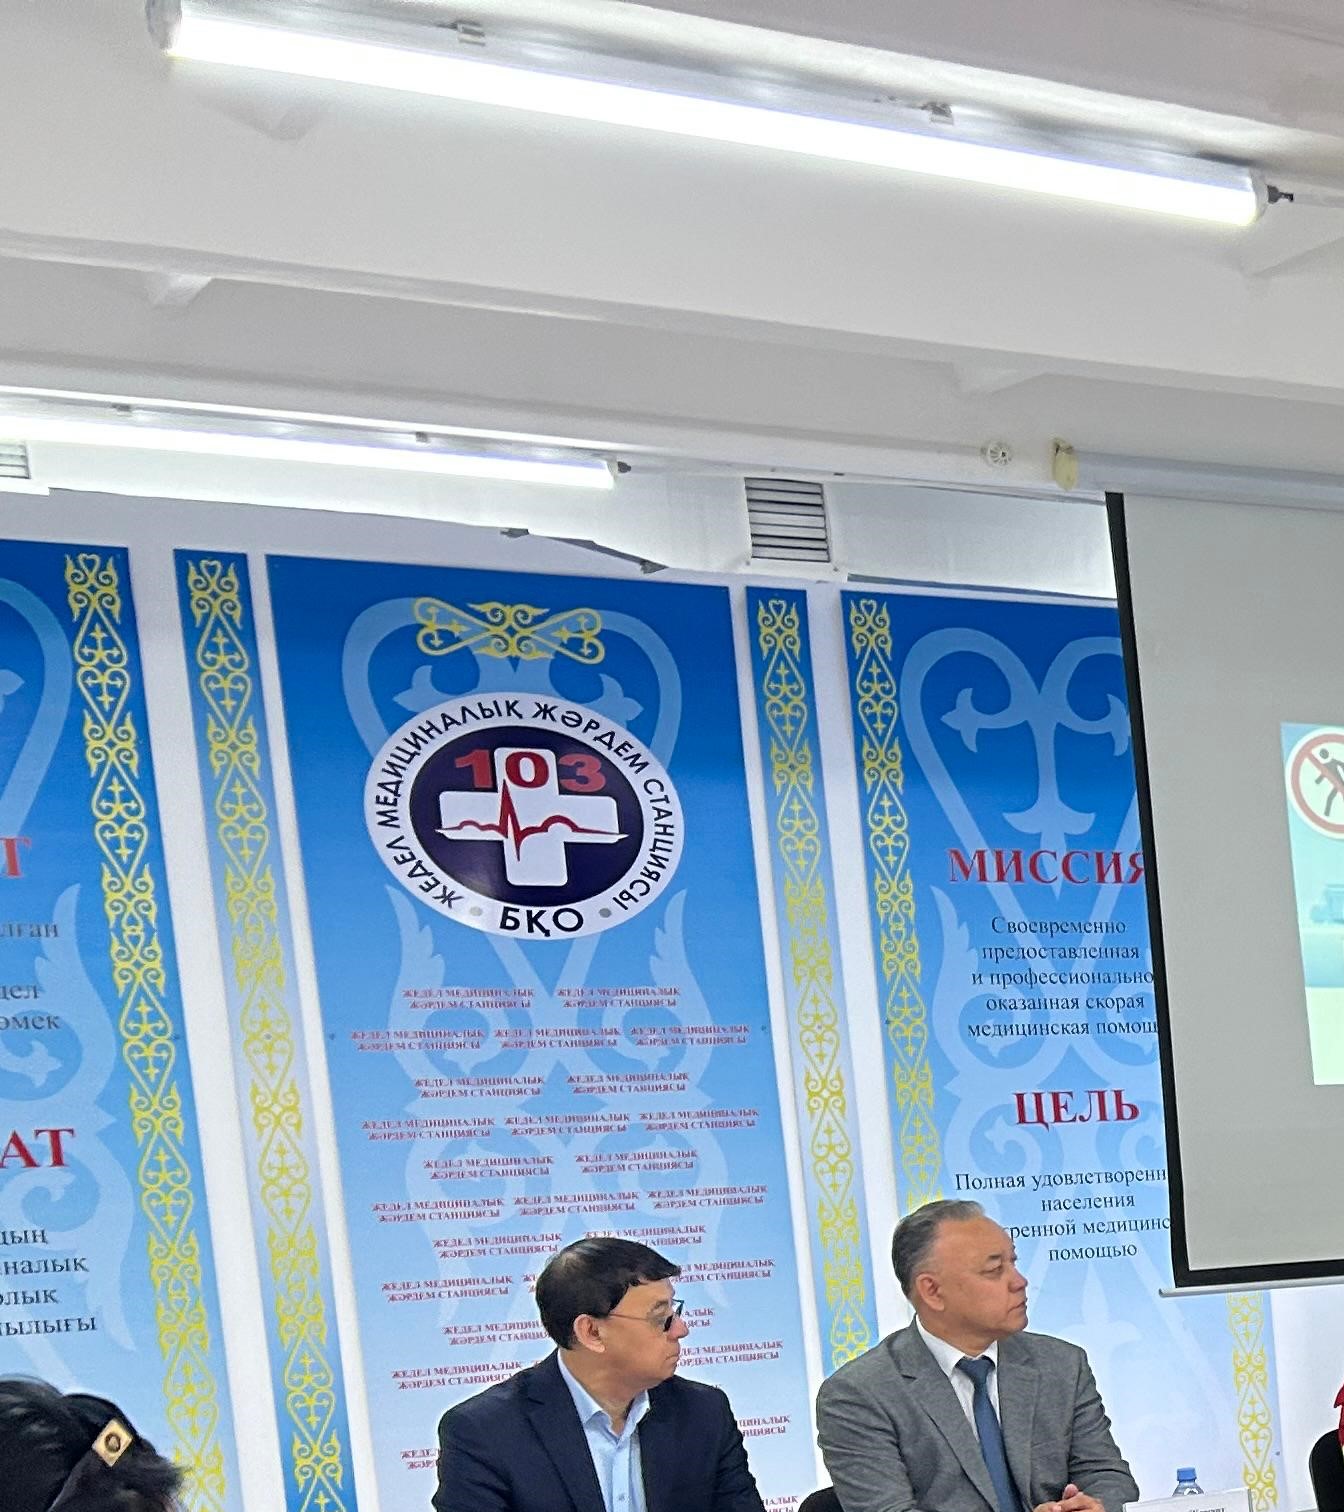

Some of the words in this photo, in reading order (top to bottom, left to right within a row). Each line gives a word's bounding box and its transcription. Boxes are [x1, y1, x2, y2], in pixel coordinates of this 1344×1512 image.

[532, 702, 649, 774] ЖӘРДЕМ
[375, 700, 523, 828] МЕДИЦИНАЛЫҚ
[455, 750, 606, 792] 103
[613, 778, 674, 910] СТАНЦИЯСЫ
[386, 836, 464, 908] ЖЕДЕЛ
[947, 848, 1145, 885] МИССИЯ
[500, 906, 584, 936] БҚО
[991, 917, 1126, 938] Своевременно
[982, 946, 1139, 963] предоставленная
[972, 972, 983, 984] и
[986, 996, 1079, 1011] оказанная
[1086, 996, 1144, 1012] скорая
[968, 1022, 1089, 1037] медицинская
[1013, 1088, 1140, 1128] ЦЕЛЬ
[0, 1128, 75, 1168] АТ
[956, 1173, 1025, 1191] Полная
[1041, 1194, 1135, 1211] населения
[1049, 1244, 1138, 1262] помощью
